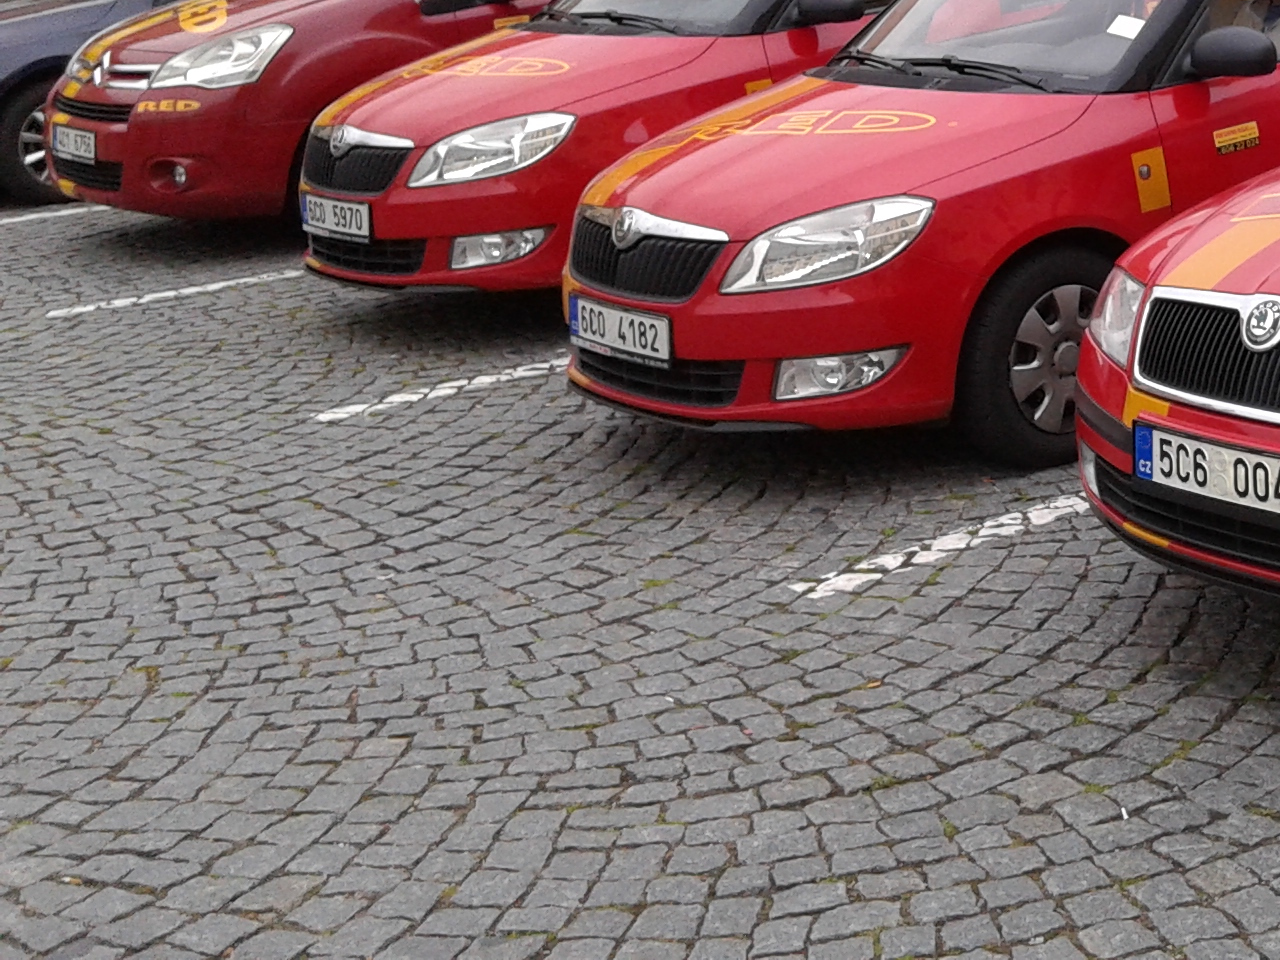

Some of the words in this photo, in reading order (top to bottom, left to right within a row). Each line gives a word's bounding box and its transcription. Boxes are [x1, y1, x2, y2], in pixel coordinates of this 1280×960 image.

[137, 98, 201, 113] RED
[332, 204, 363, 231] 5970
[581, 305, 606, 339] 6C0
[618, 316, 660, 353] 4182
[1138, 459, 1152, 475] CZ
[1158, 437, 1209, 488] 5C6
